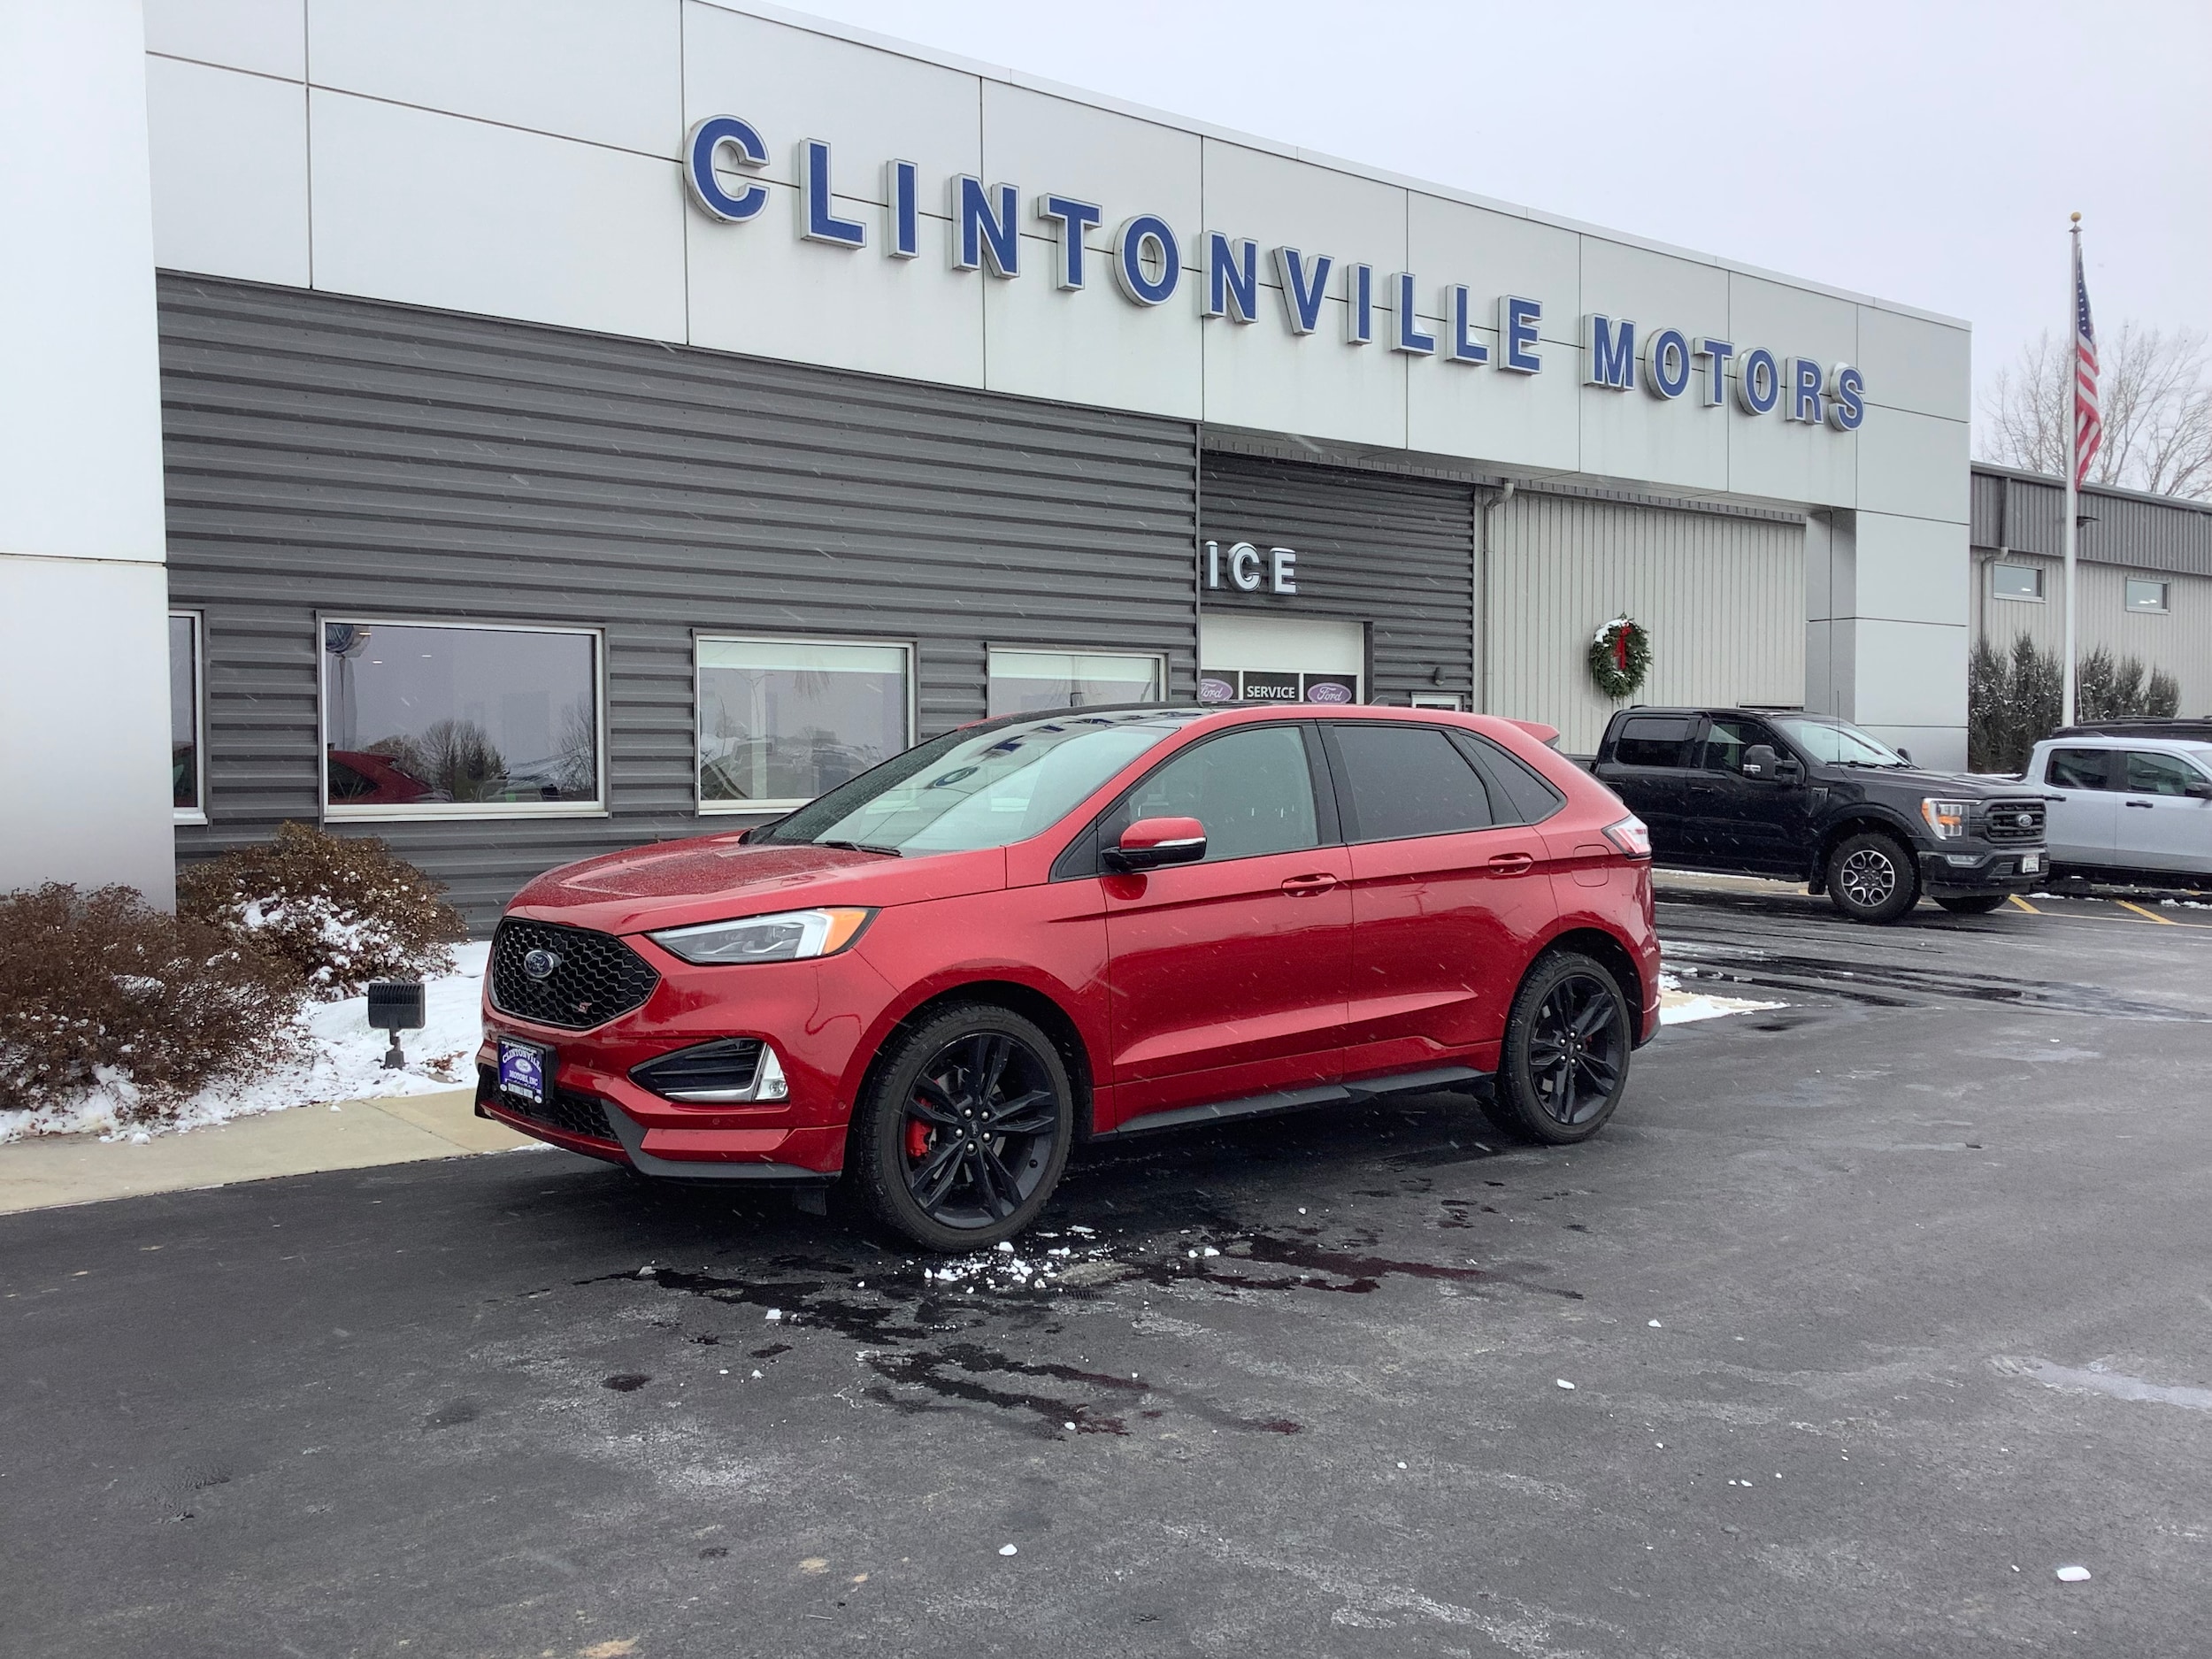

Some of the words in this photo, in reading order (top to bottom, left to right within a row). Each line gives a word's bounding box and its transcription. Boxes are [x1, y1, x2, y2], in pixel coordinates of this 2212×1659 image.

[683, 114, 1542, 375] CLINTONVILLE
[1583, 312, 1866, 432] MOTORS
[1247, 686, 1295, 699] SERVICE
[1317, 687, 1342, 702] Ford
